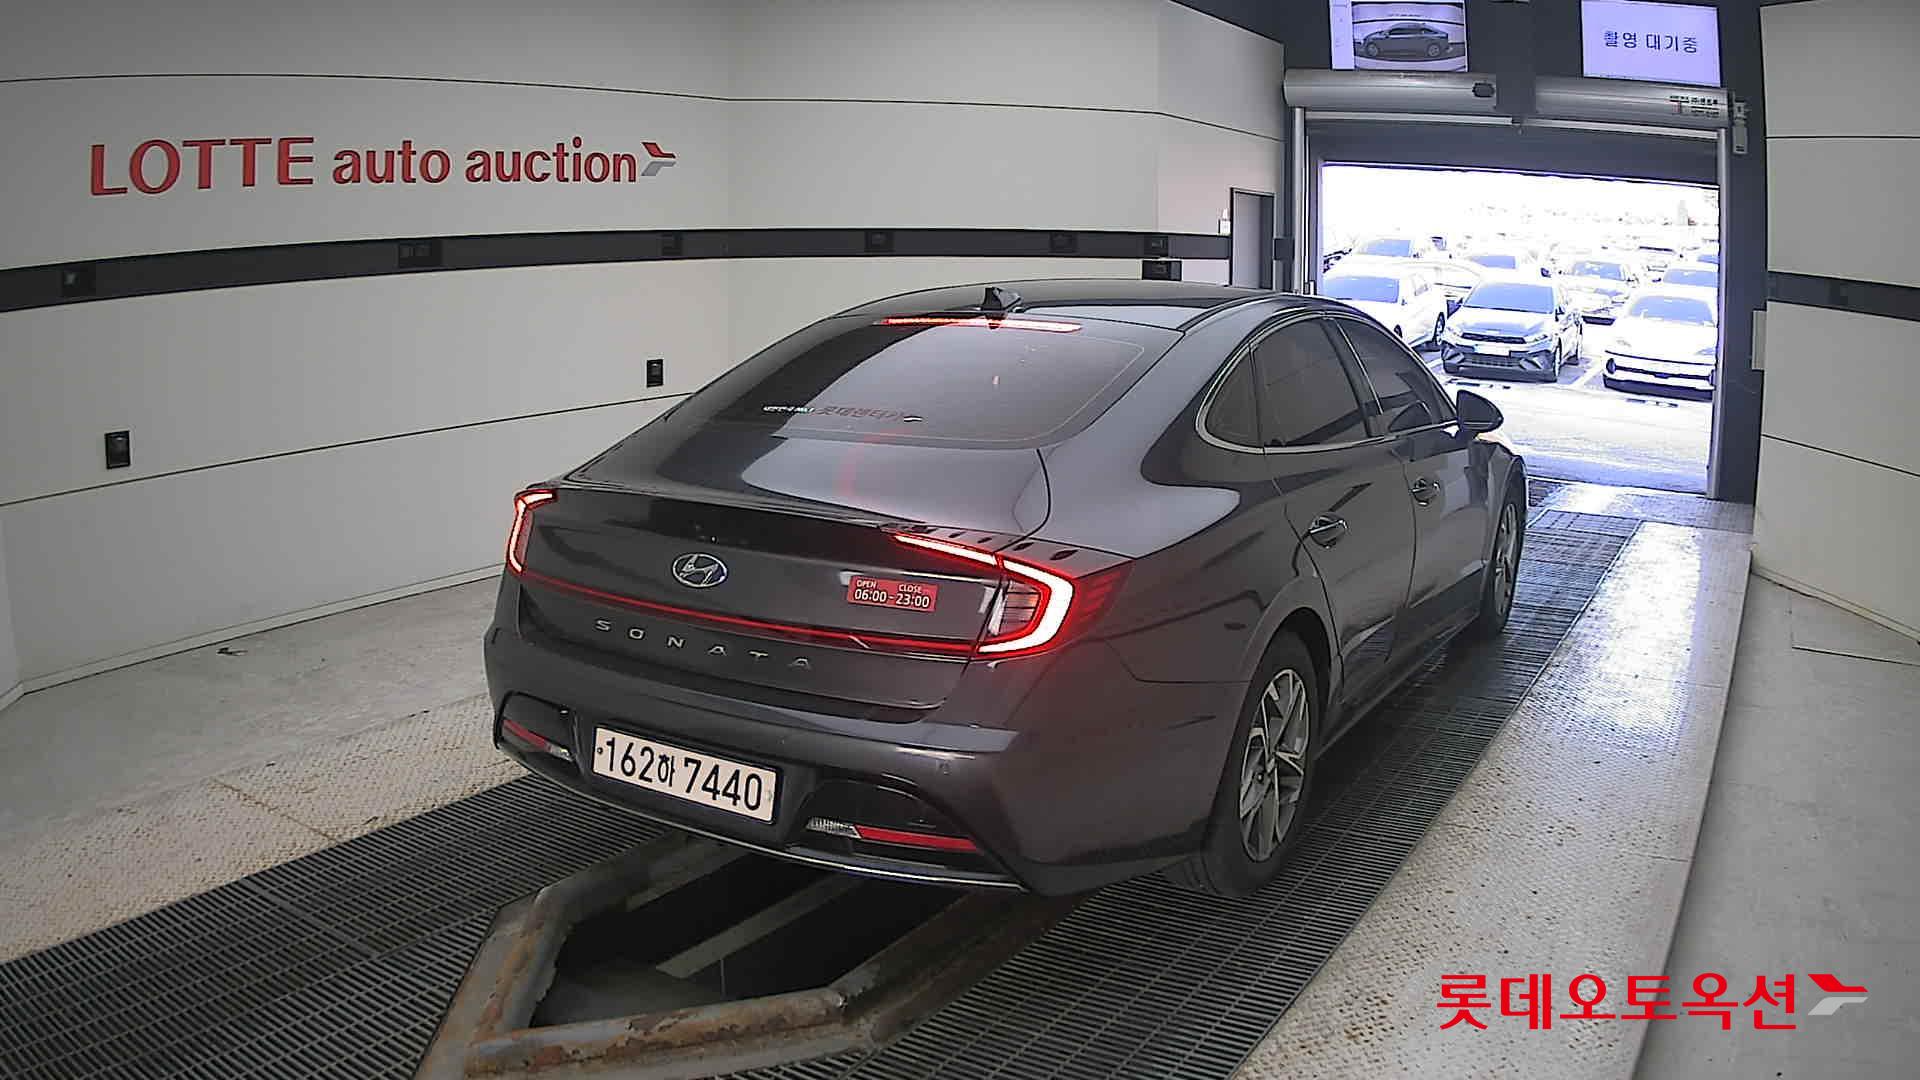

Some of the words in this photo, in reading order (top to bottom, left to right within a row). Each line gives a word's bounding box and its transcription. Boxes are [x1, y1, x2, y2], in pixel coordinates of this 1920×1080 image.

[1604, 30, 1637, 49] 촬영
[1646, 33, 1697, 53] 대기중
[91, 137, 314, 195] LOTTE
[333, 140, 451, 184] auto
[465, 137, 637, 182] auction
[856, 580, 877, 588] OPEN
[898, 584, 922, 593] CLOSE
[596, 619, 811, 670] SONATA
[606, 737, 675, 787] 162하
[684, 757, 762, 811] 7440
